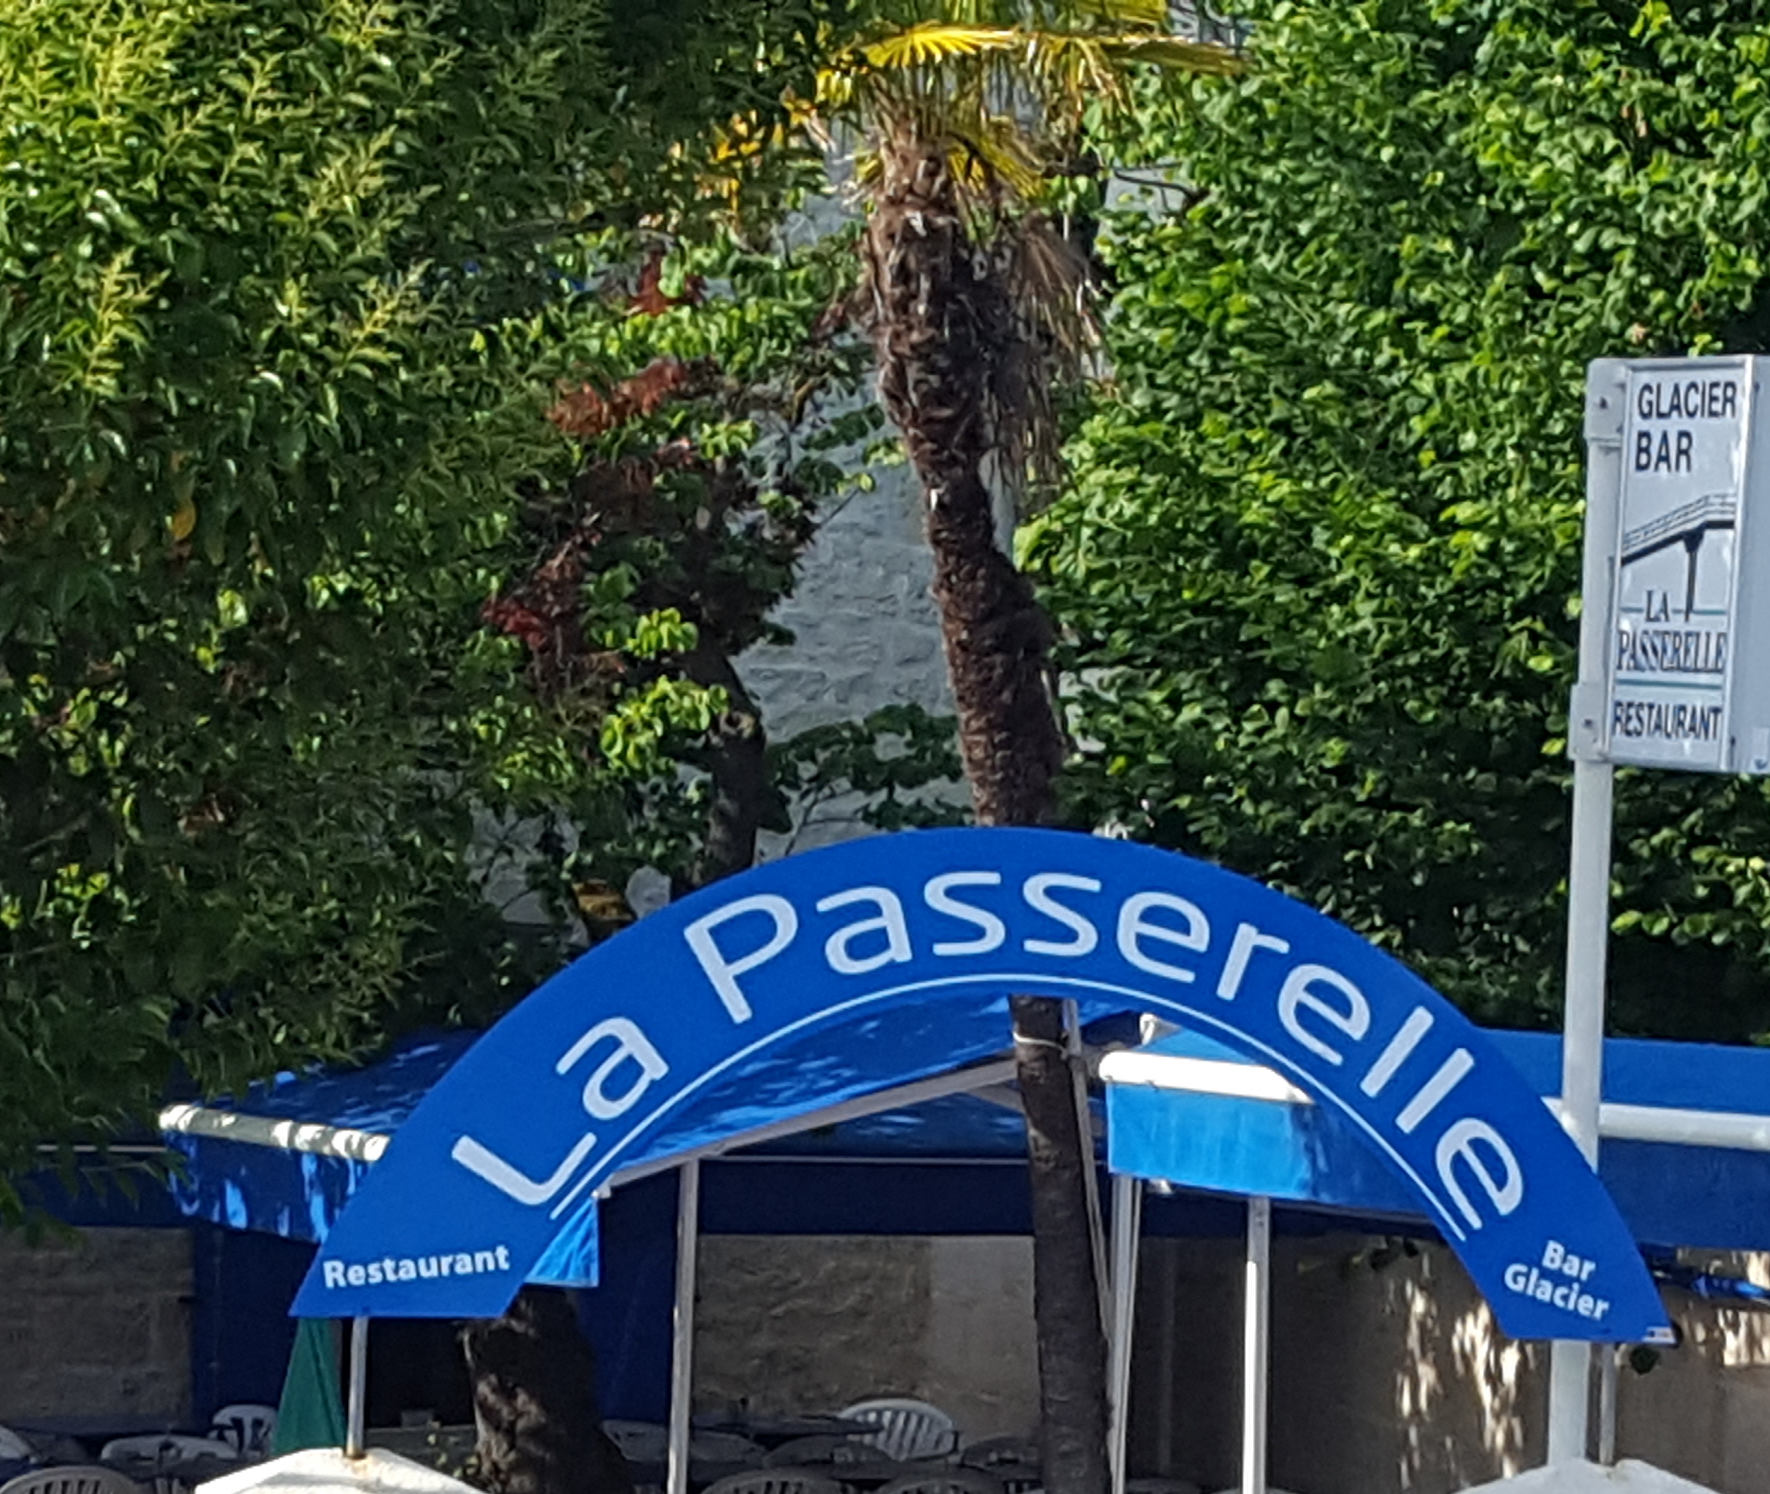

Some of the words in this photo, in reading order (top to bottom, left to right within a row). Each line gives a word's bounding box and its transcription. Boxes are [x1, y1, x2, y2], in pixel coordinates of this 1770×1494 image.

[1637, 380, 1737, 420] GLACIER
[1634, 430, 1693, 473] BAR
[1645, 589, 1671, 623] LA
[1617, 630, 1727, 676] PASSERELLE
[1612, 701, 1723, 742] RESTAURANT
[451, 1016, 670, 1207] La
[683, 870, 1525, 1230] Passerelle
[323, 1245, 511, 1289] Restaurant
[1541, 1240, 1597, 1283] Bar
[1504, 1263, 1610, 1321] Glacier
